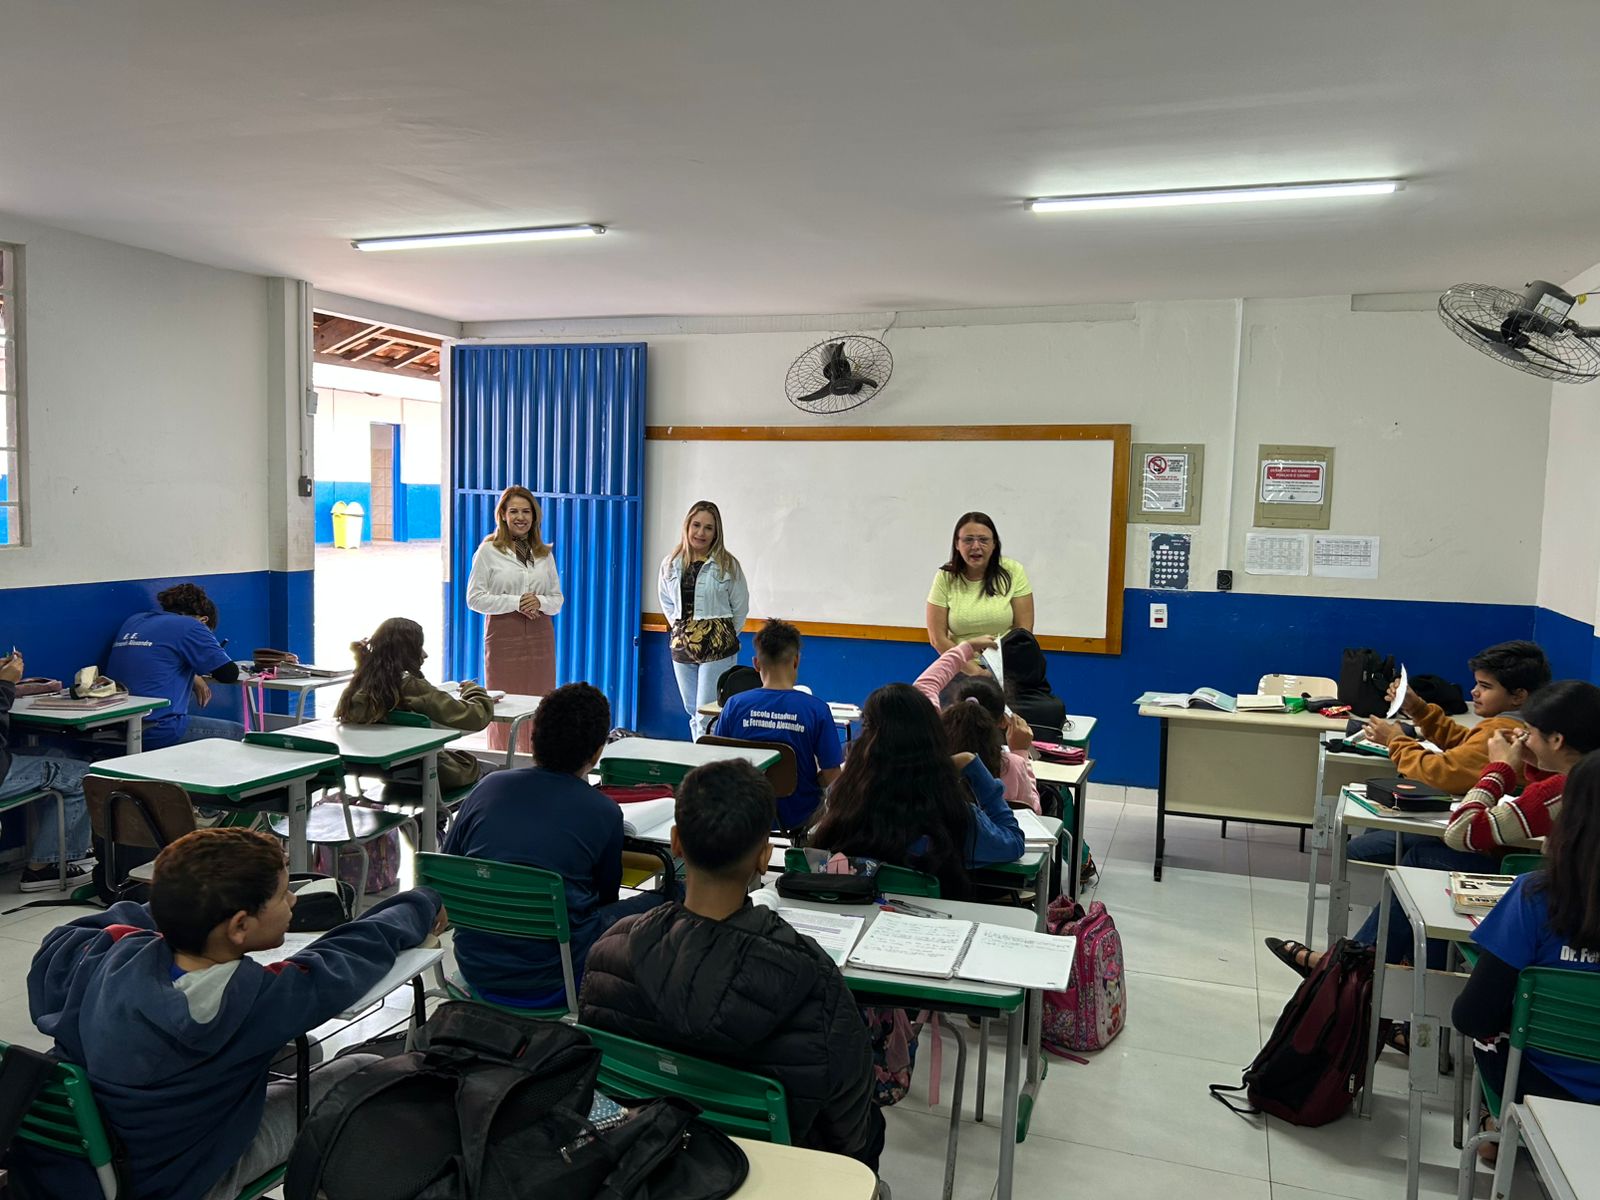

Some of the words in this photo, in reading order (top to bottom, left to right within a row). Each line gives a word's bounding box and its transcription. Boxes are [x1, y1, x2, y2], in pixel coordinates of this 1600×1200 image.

[750, 710, 770, 718] Escola
[771, 712, 798, 721] Estadual
[1560, 946, 1578, 962] Dr.
